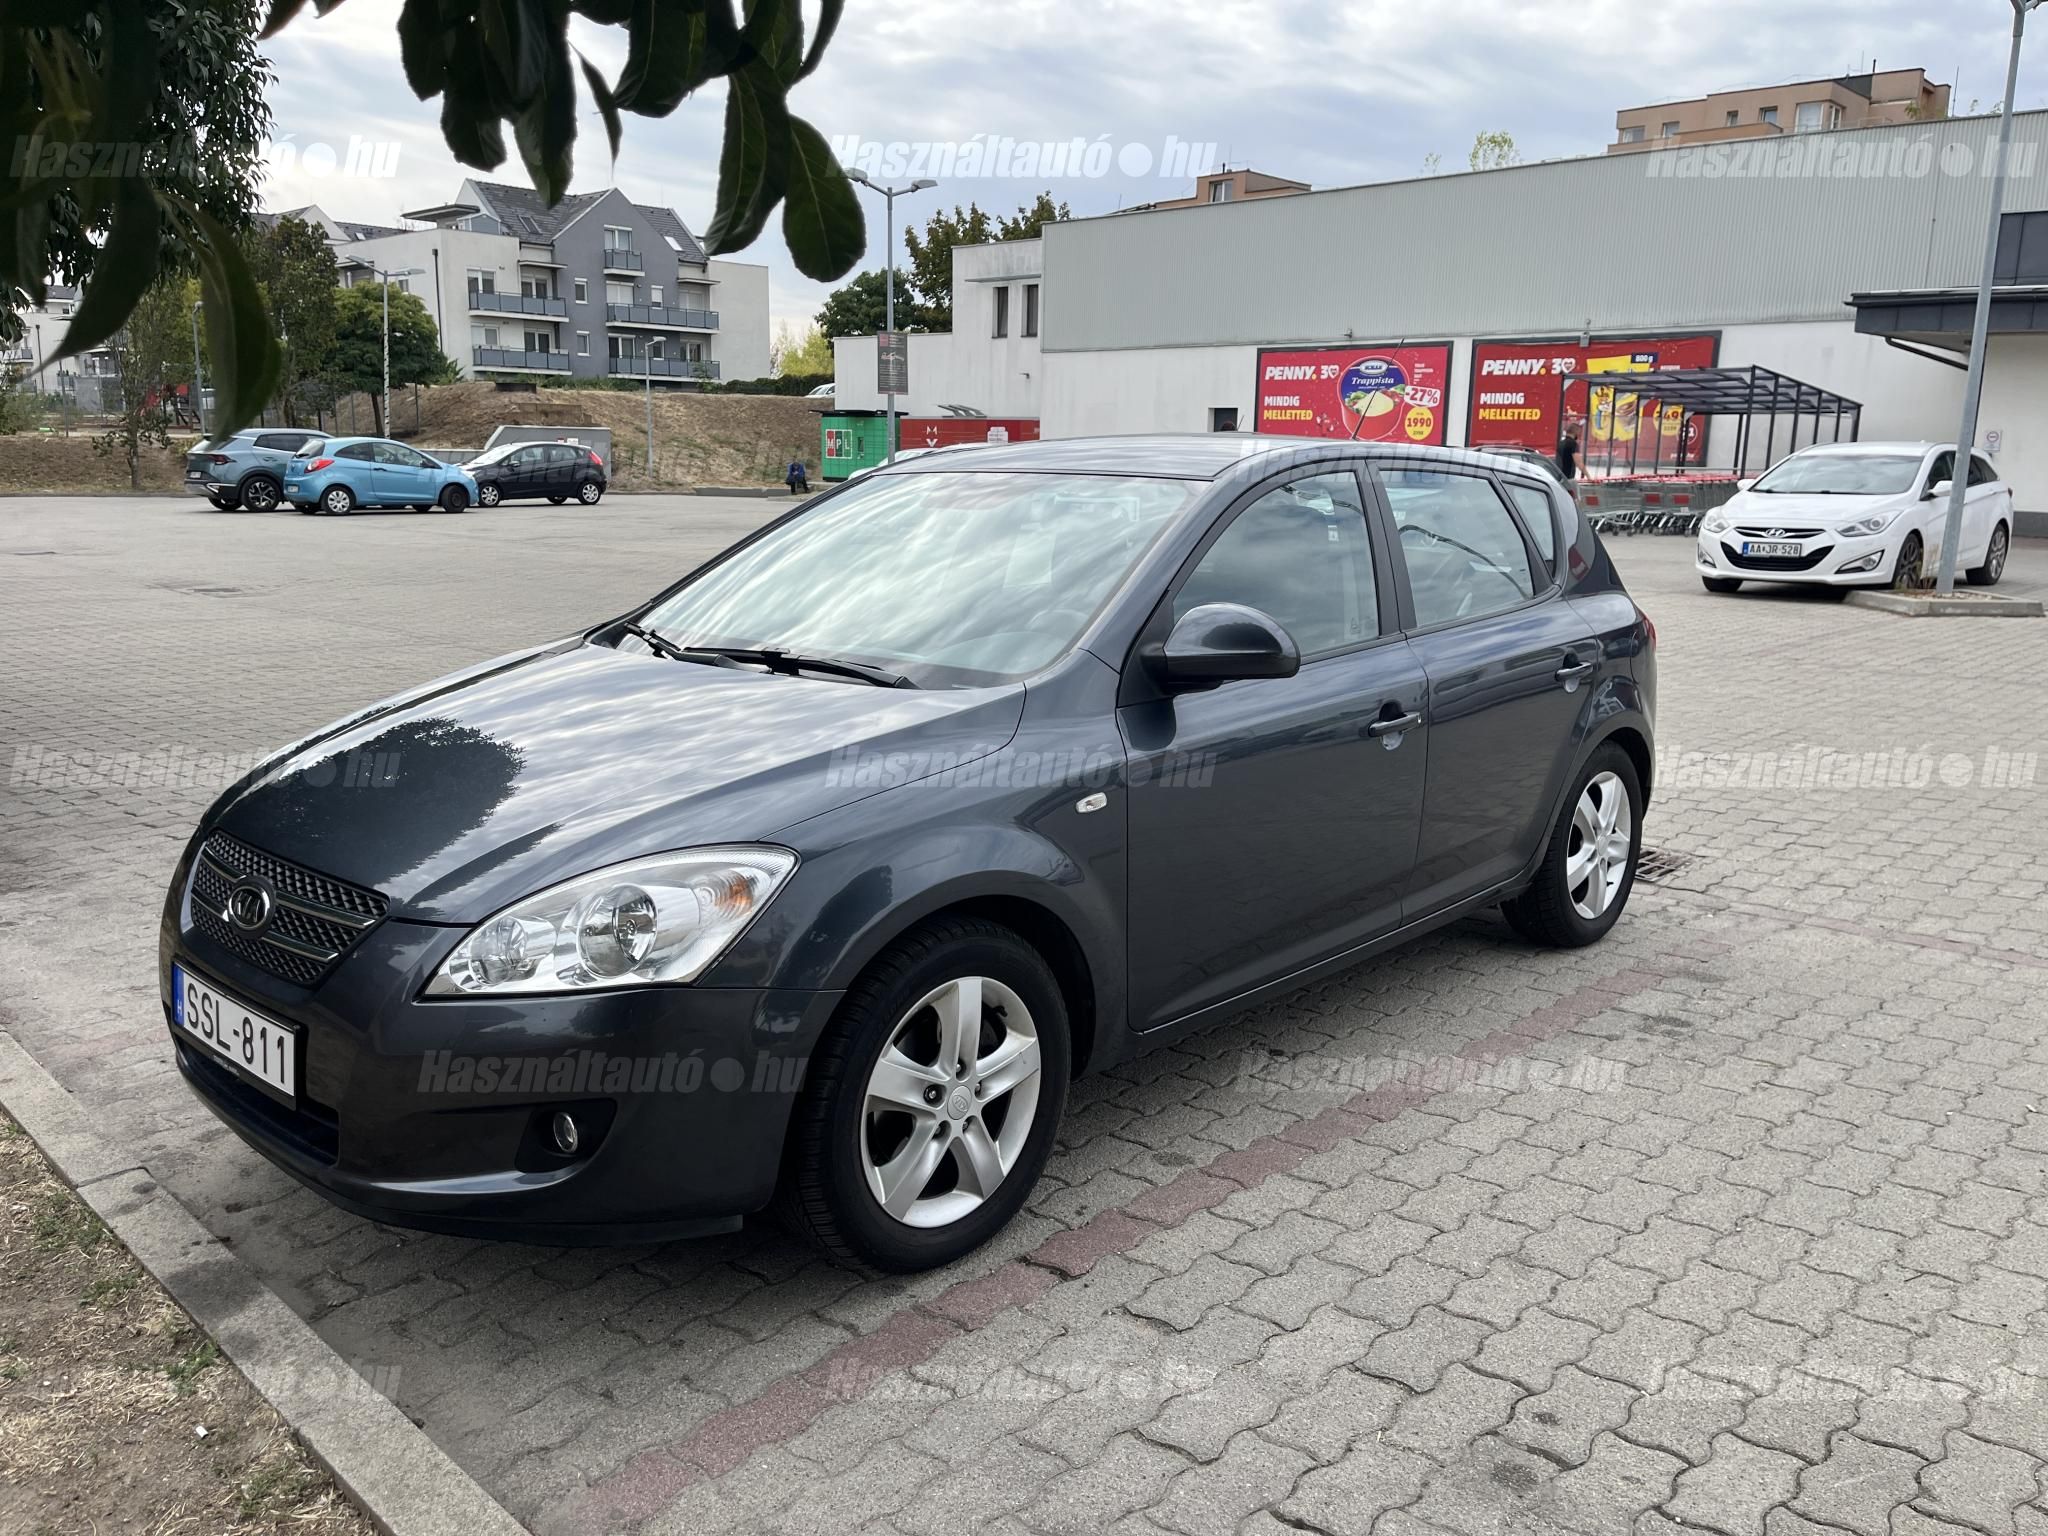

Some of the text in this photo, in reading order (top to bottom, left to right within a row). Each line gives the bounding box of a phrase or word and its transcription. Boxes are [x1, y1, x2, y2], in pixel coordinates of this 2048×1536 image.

[1264, 395, 1300, 407] MINDIG
[1480, 392, 1525, 405] MINDIG
[1263, 409, 1313, 421] MELLETTED
[1479, 408, 1541, 421] MELLETTED
[1406, 417, 1432, 428] 1990
[186, 982, 286, 1085] SSL-811
